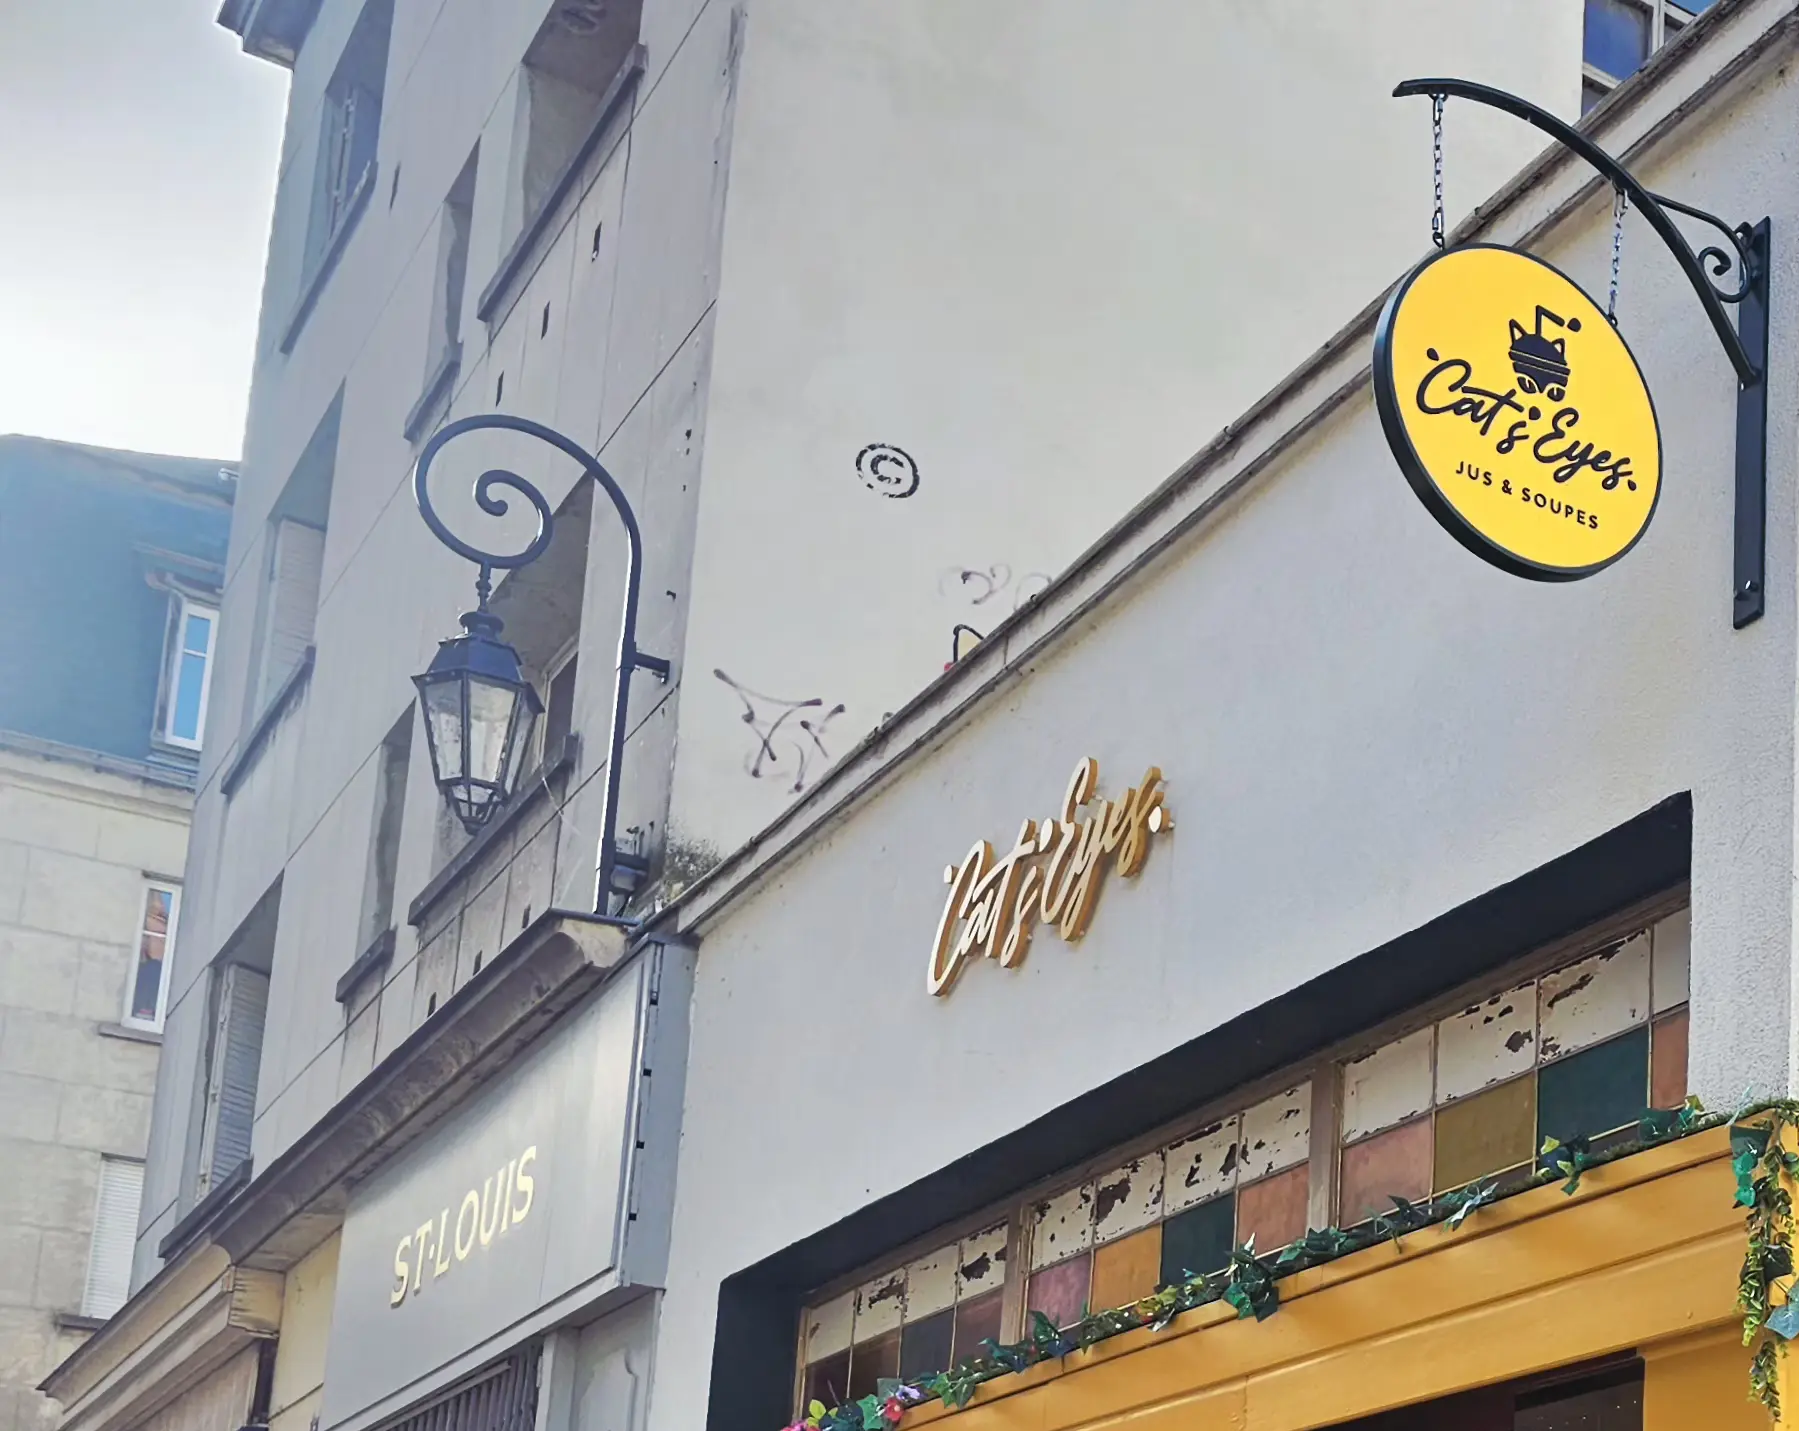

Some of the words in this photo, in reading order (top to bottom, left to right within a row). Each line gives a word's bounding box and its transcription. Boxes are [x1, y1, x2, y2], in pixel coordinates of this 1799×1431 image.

[1456, 460, 1493, 486] JUS
[1501, 480, 1513, 495] &
[1522, 487, 1598, 529] SOUPES
